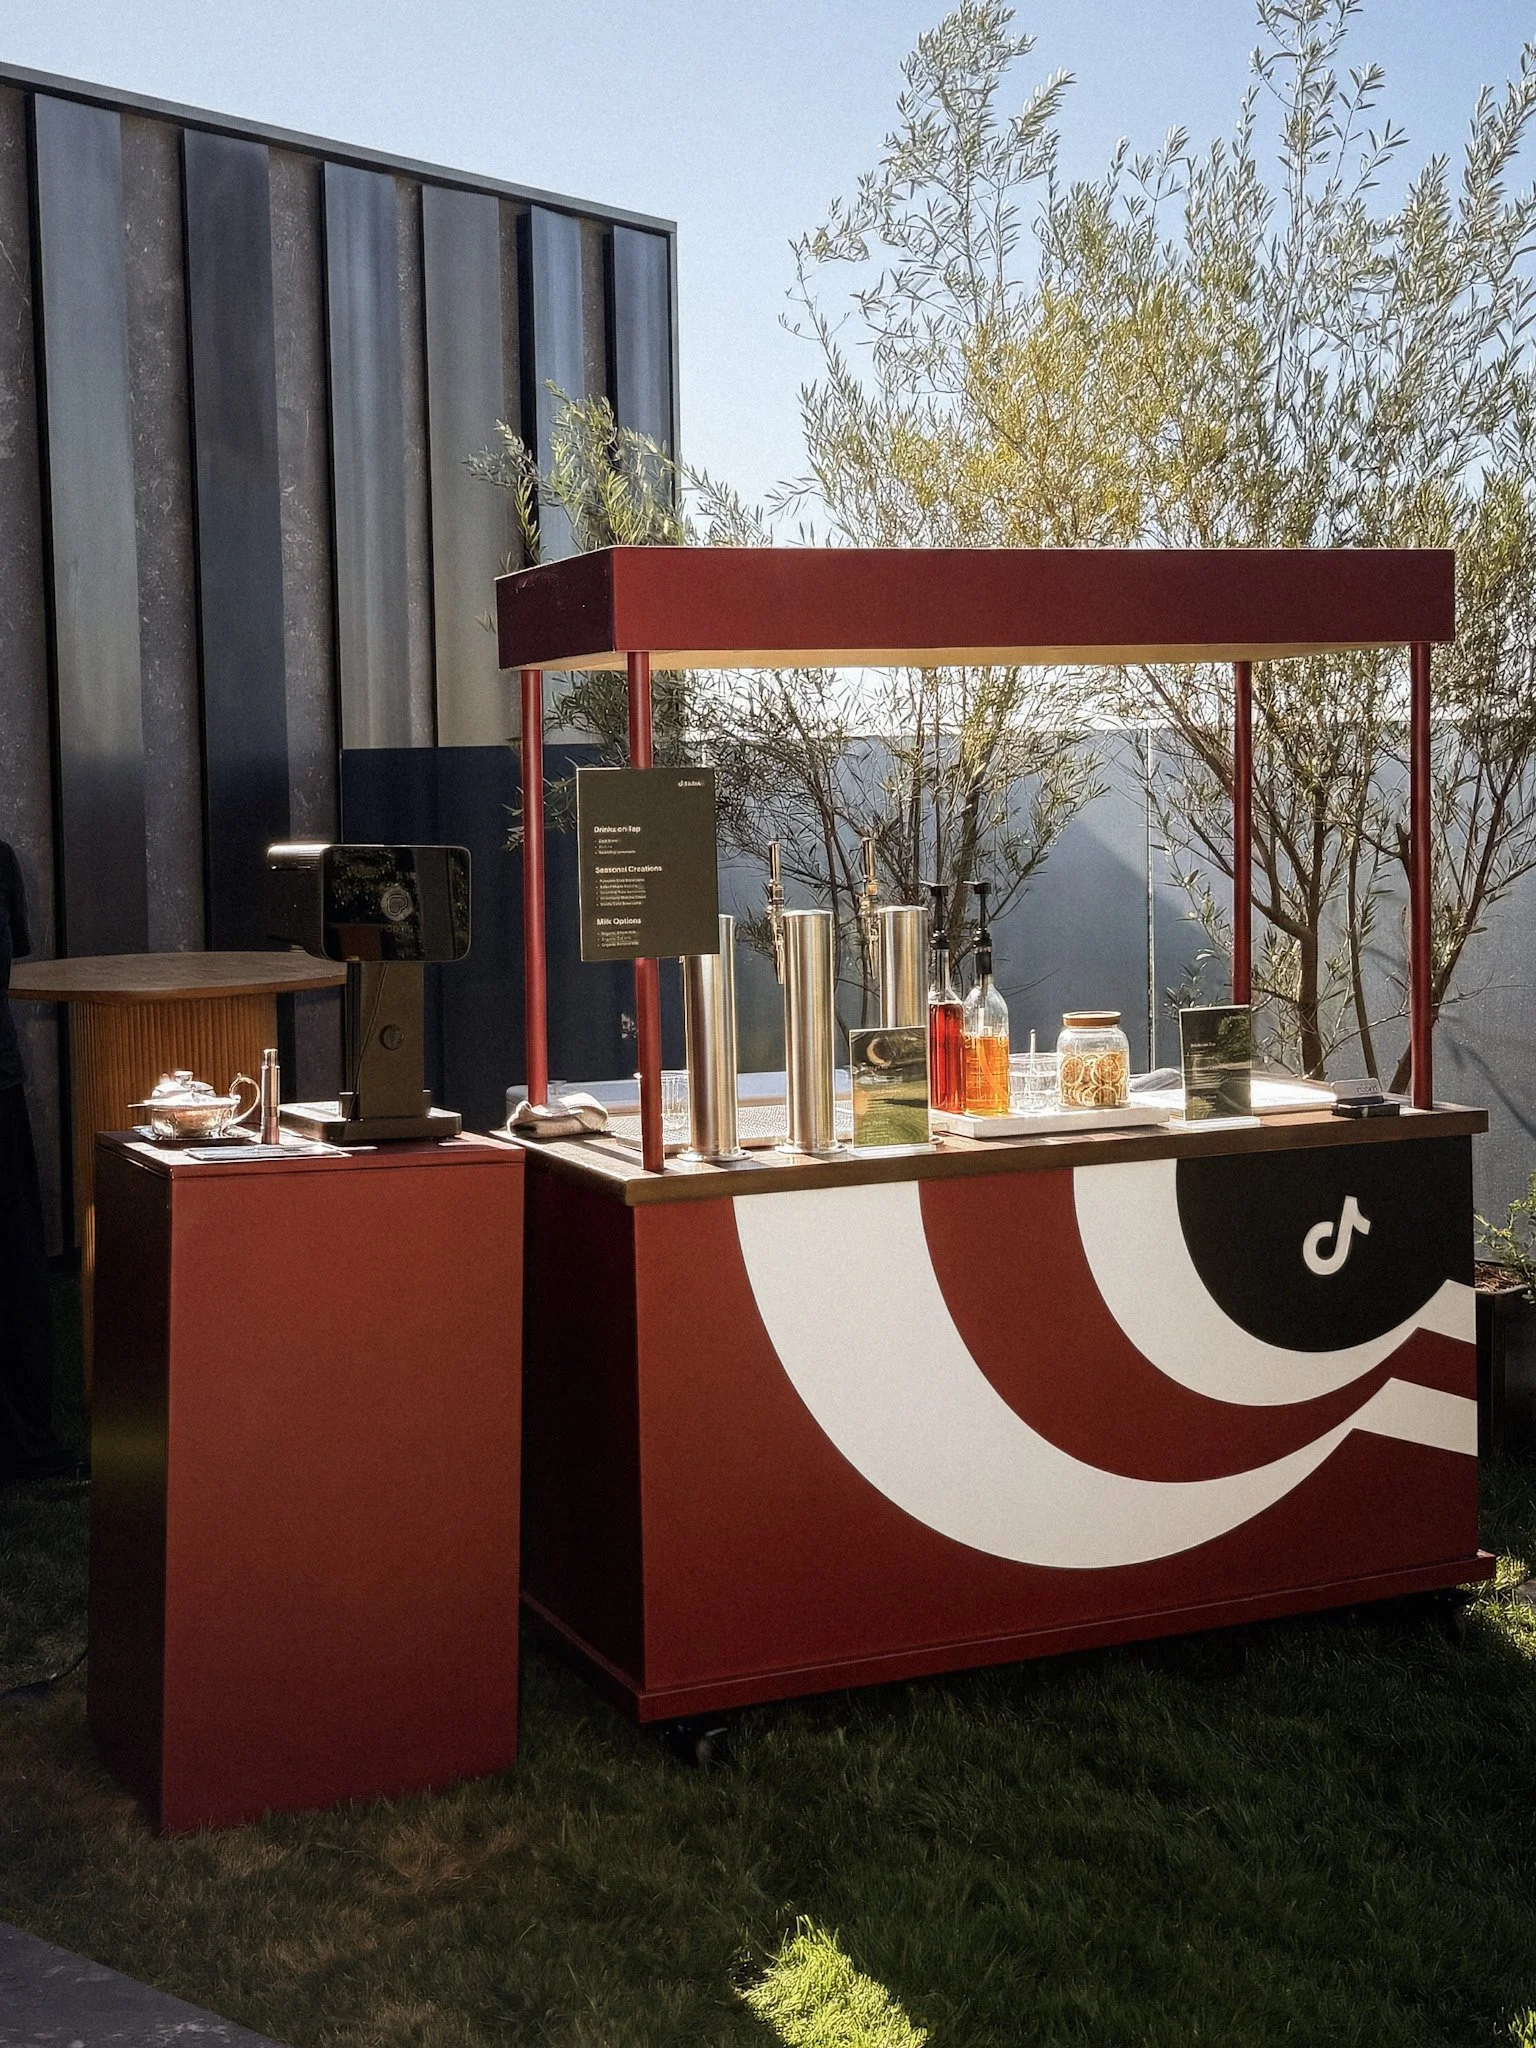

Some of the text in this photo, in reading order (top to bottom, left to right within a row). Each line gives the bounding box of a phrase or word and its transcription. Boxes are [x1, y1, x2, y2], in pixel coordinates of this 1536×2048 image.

[594, 825, 616, 833] Drinks
[628, 825, 641, 834] Tap
[595, 865, 663, 874] Seasonal Creations
[596, 917, 642, 926] Milk Options
